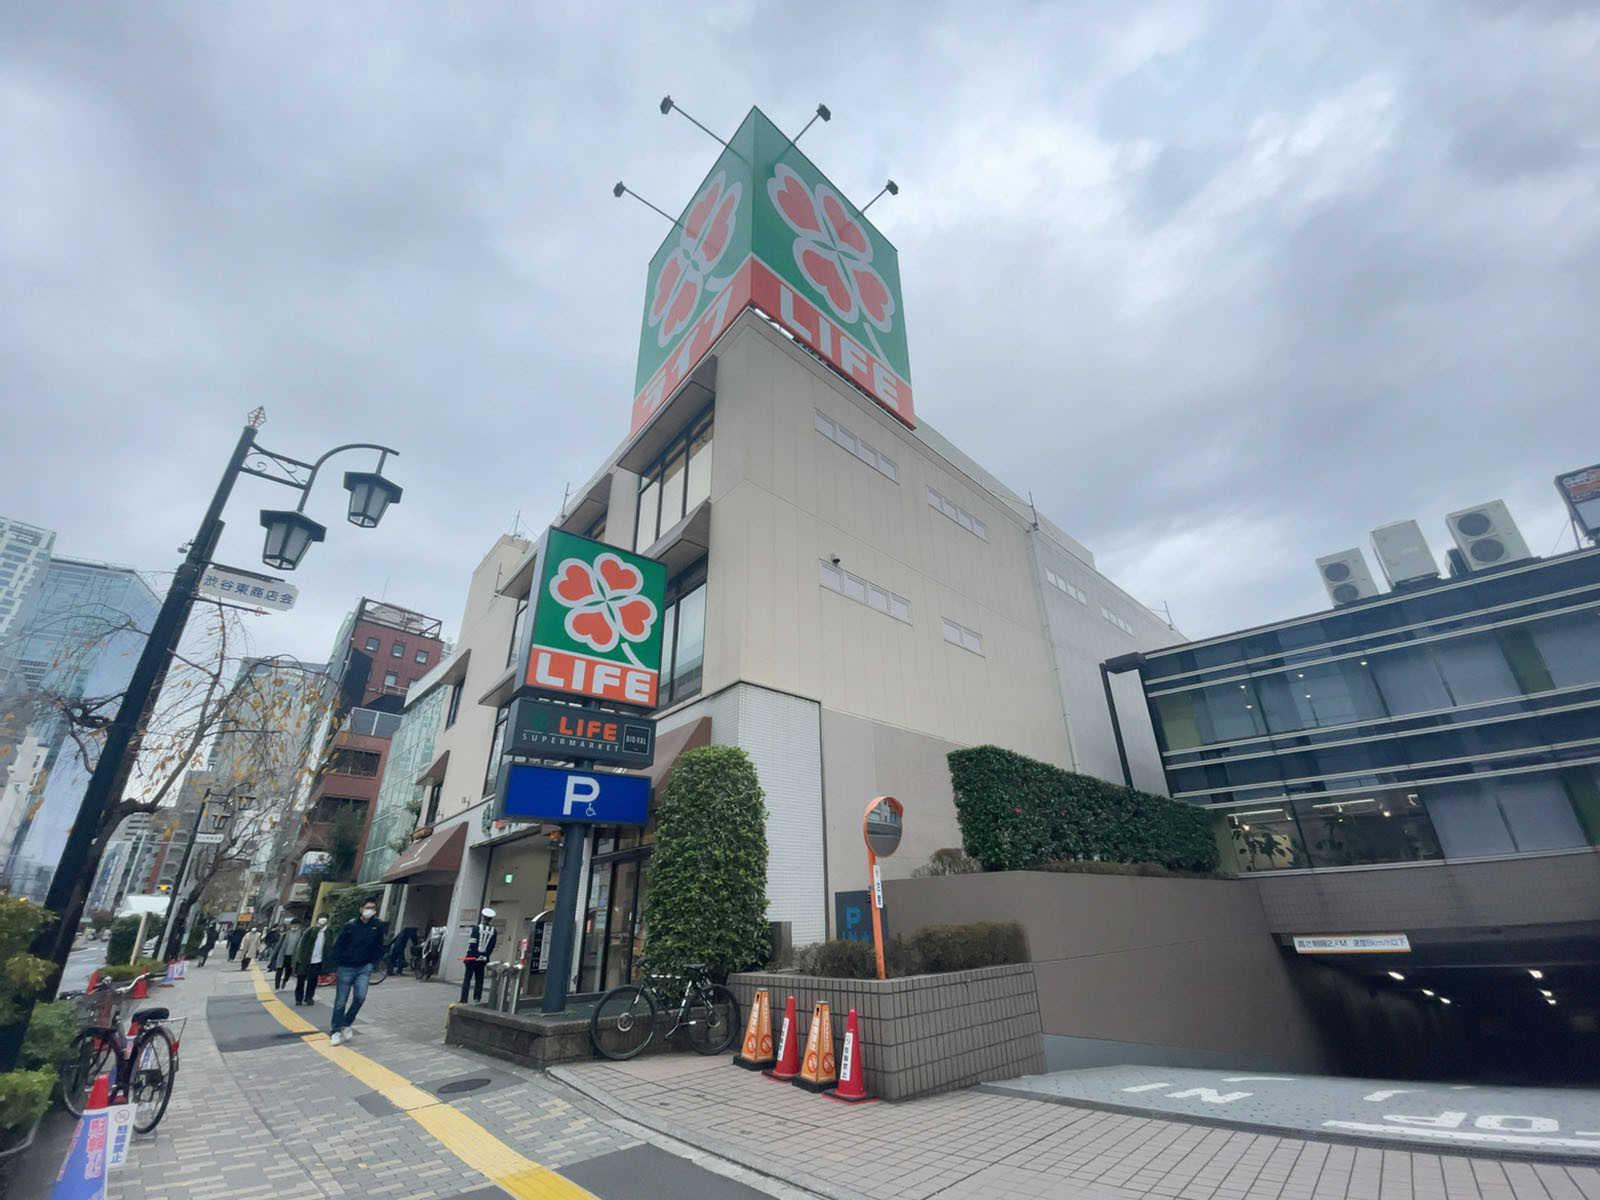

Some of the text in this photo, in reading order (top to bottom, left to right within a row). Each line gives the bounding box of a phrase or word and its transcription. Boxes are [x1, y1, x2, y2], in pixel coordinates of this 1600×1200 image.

[780, 286, 899, 411] LIFE
[203, 575, 294, 605] 渋谷東商店会
[535, 652, 651, 702] LIFE
[559, 716, 618, 741] LIFE
[521, 733, 619, 752] SUPERMARKET
[562, 775, 600, 815] P
[846, 907, 862, 929] P
[1120, 1082, 1254, 1104] IN
